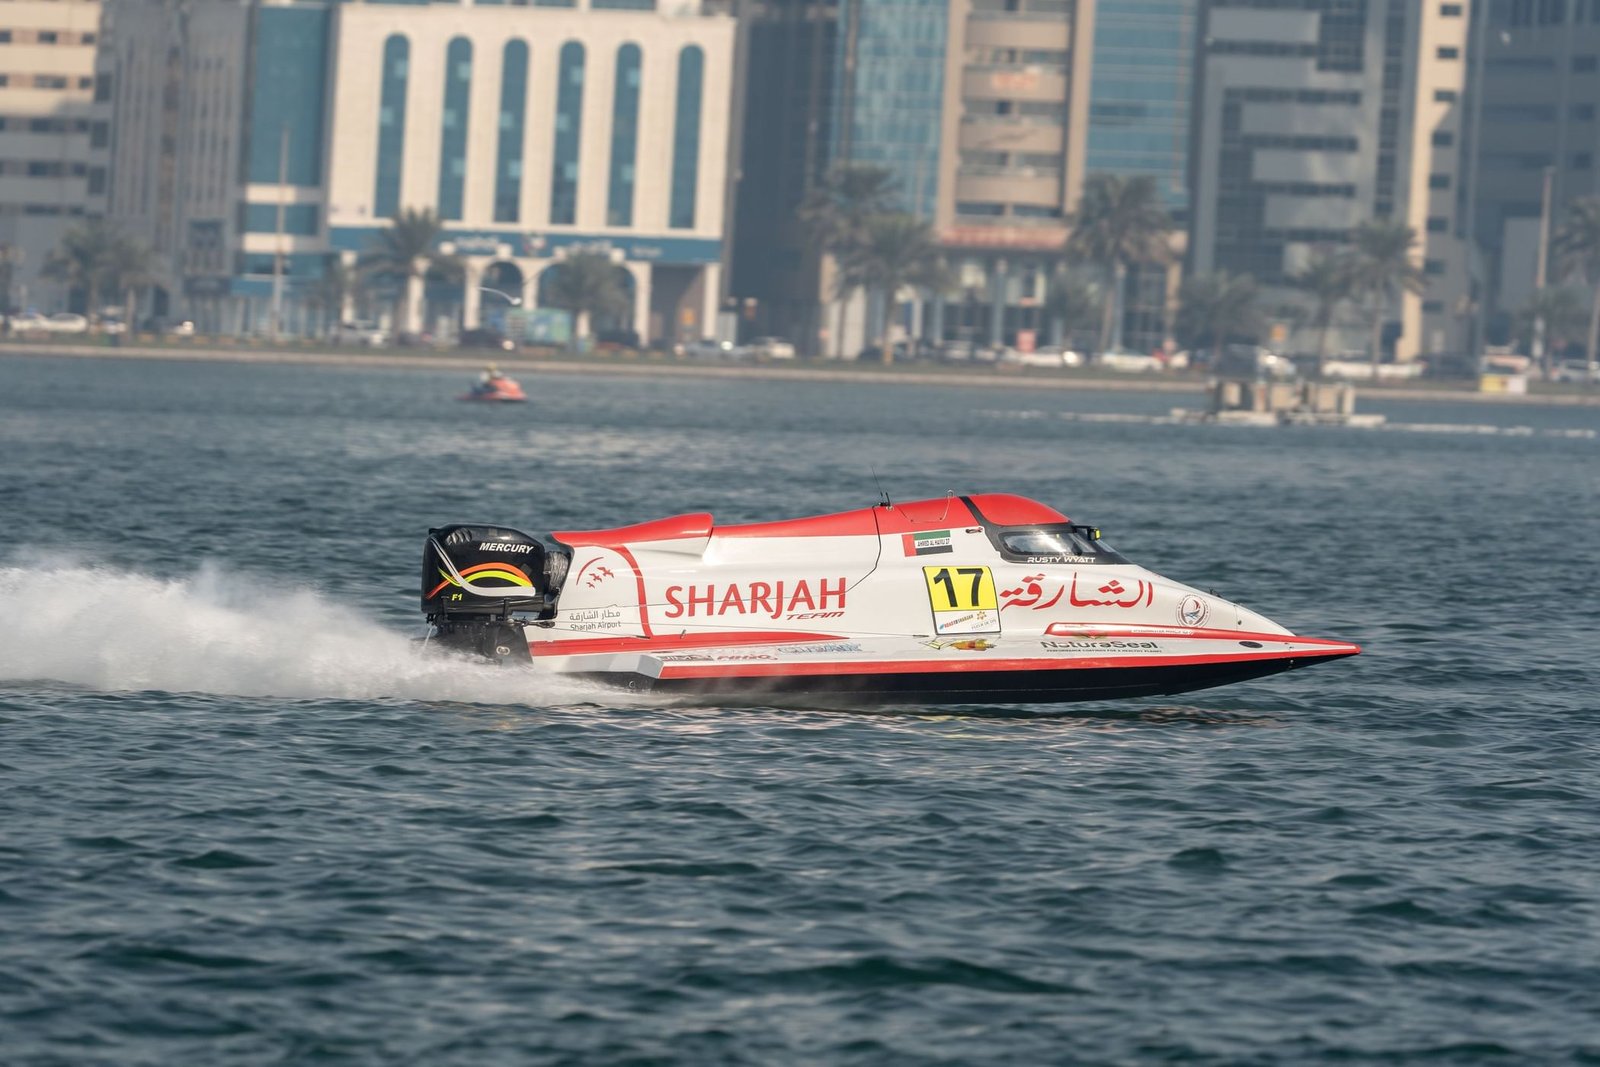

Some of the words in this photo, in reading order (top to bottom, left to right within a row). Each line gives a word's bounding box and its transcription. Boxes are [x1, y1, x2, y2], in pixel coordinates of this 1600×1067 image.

[479, 542, 534, 554] MERCURY
[933, 568, 984, 608] 17
[999, 572, 1154, 612] الشارقة
[451, 593, 463, 601] F1
[664, 577, 847, 620] SHARJAH
[569, 610, 599, 621] الشارقة
[601, 609, 621, 620] مطار
[786, 611, 845, 621] TEAM
[570, 622, 597, 631] Sharjah
[597, 620, 621, 629] Airport
